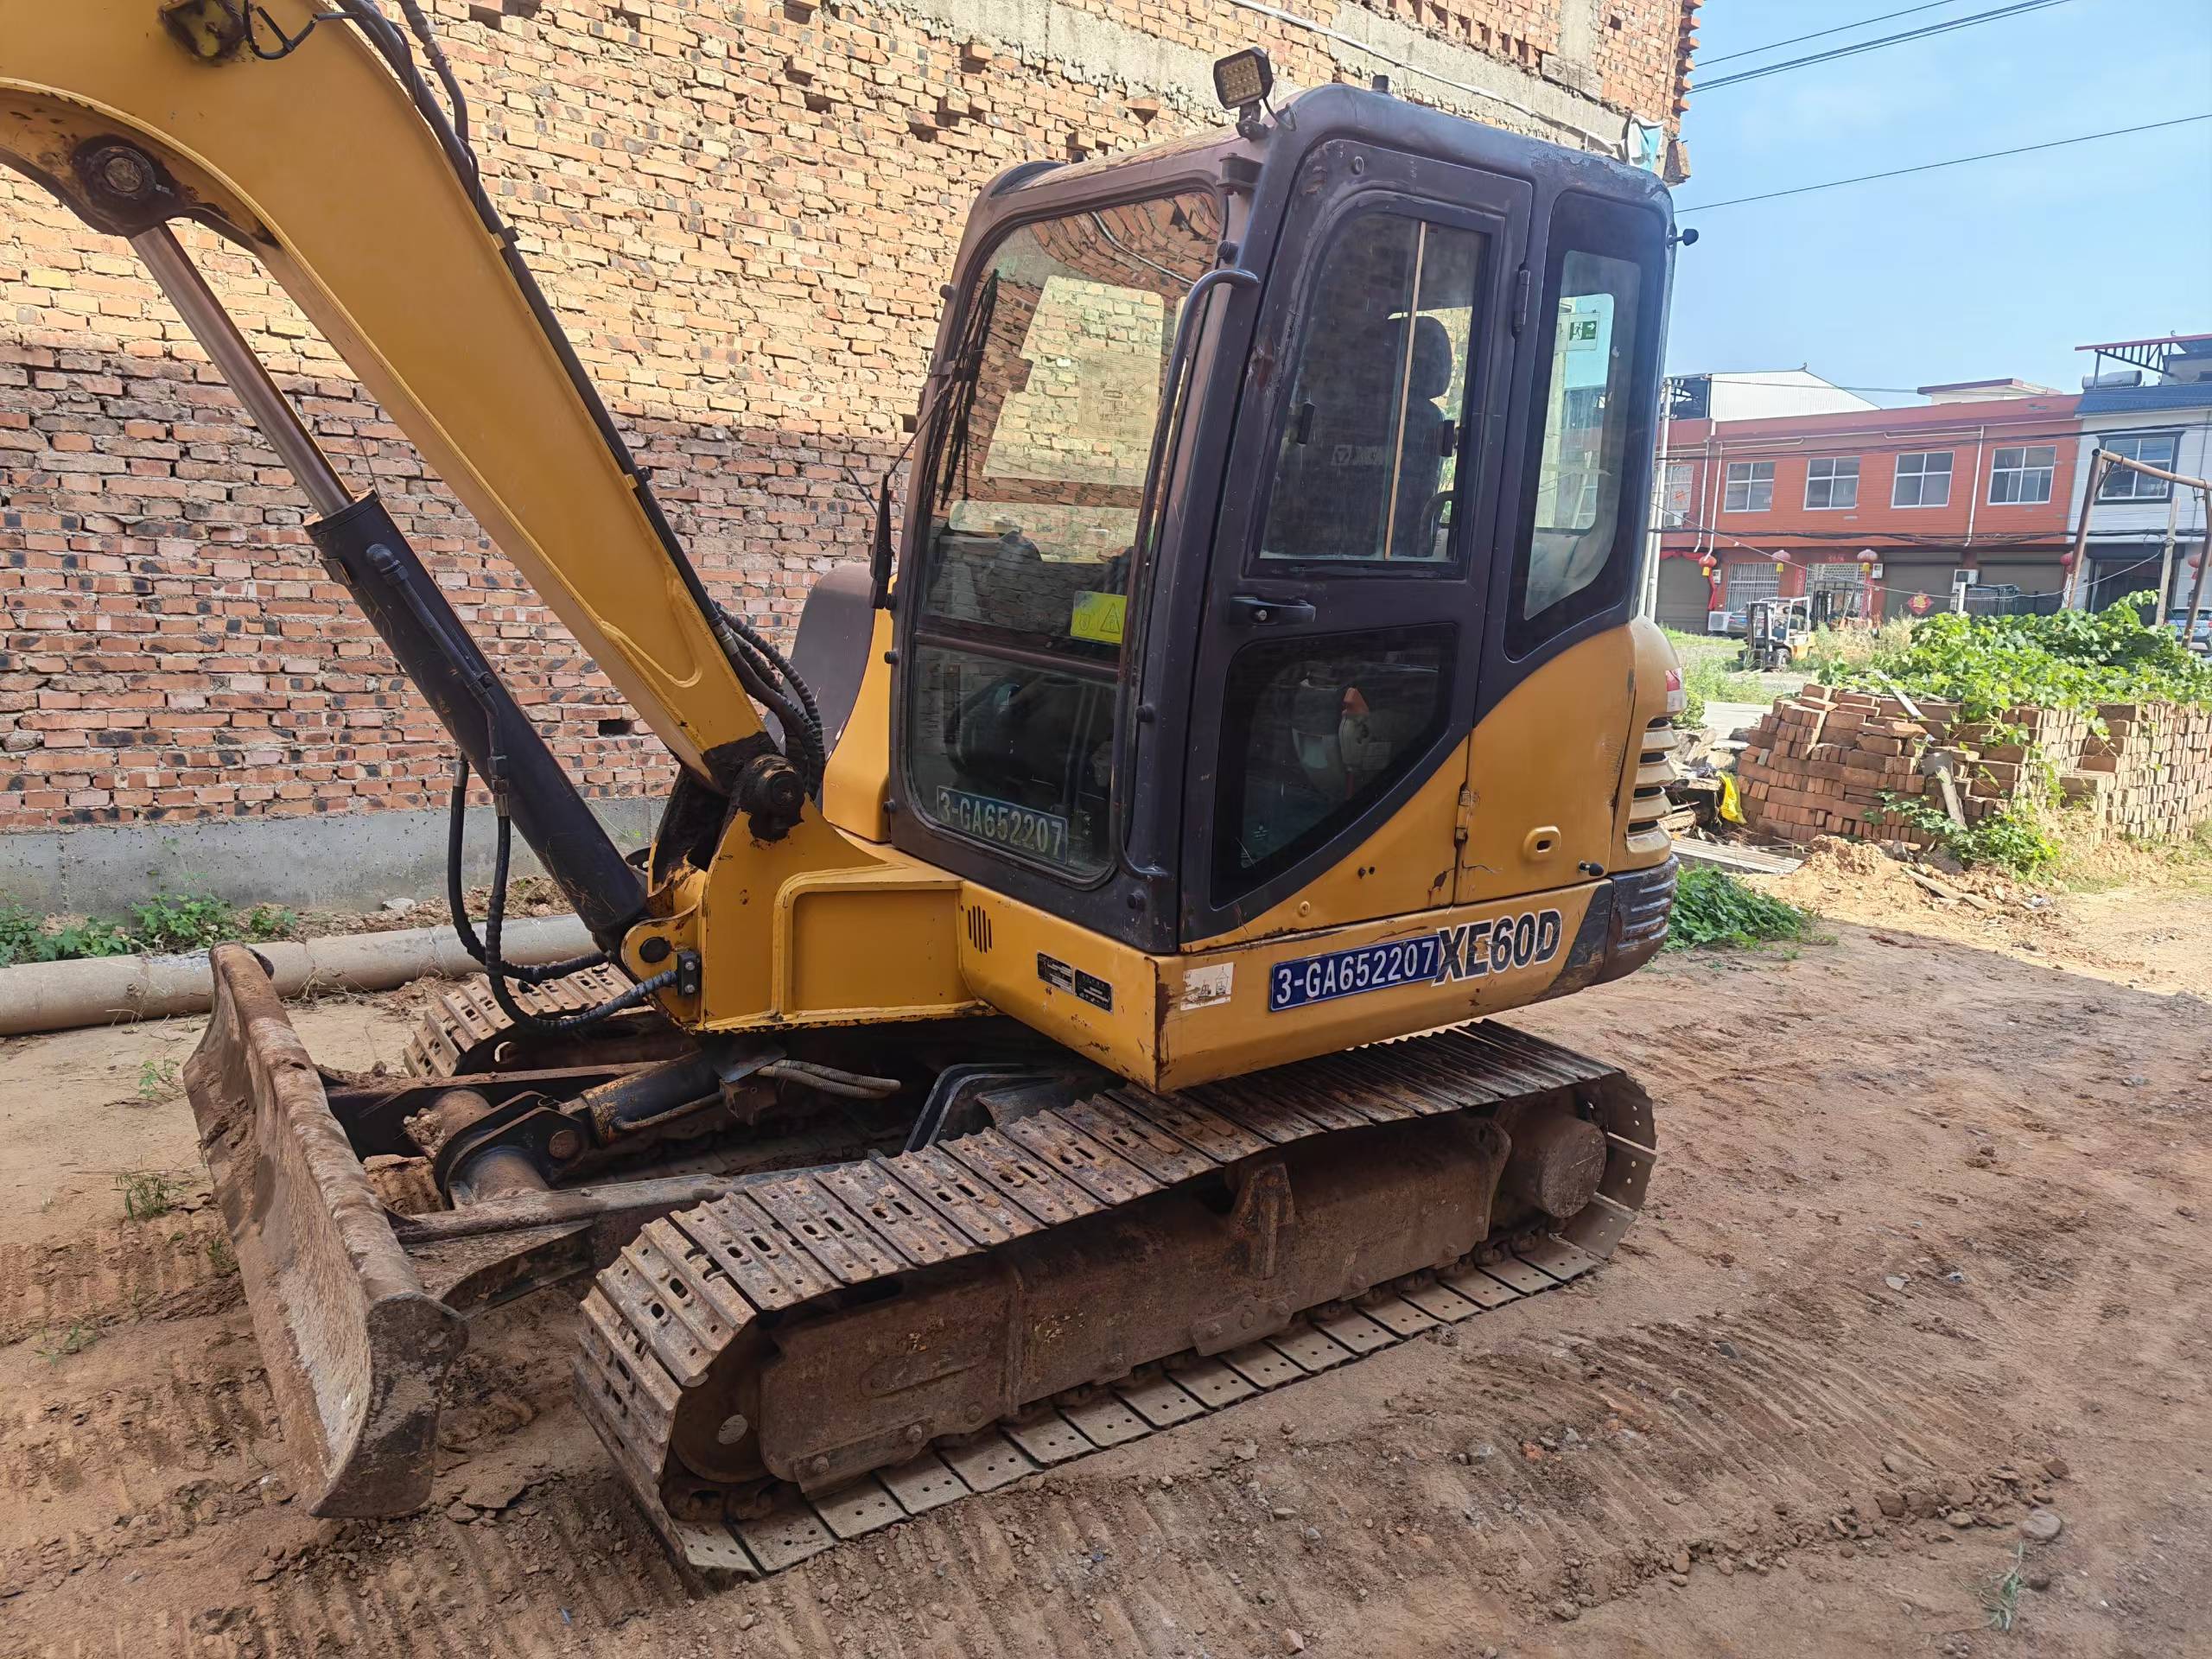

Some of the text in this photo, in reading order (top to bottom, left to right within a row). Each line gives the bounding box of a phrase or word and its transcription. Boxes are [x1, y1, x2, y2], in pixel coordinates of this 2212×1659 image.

[940, 791, 1063, 855] 3-GA652207
[1276, 940, 1435, 1004] 3-GA652207
[1431, 908, 1563, 988] XE60D
